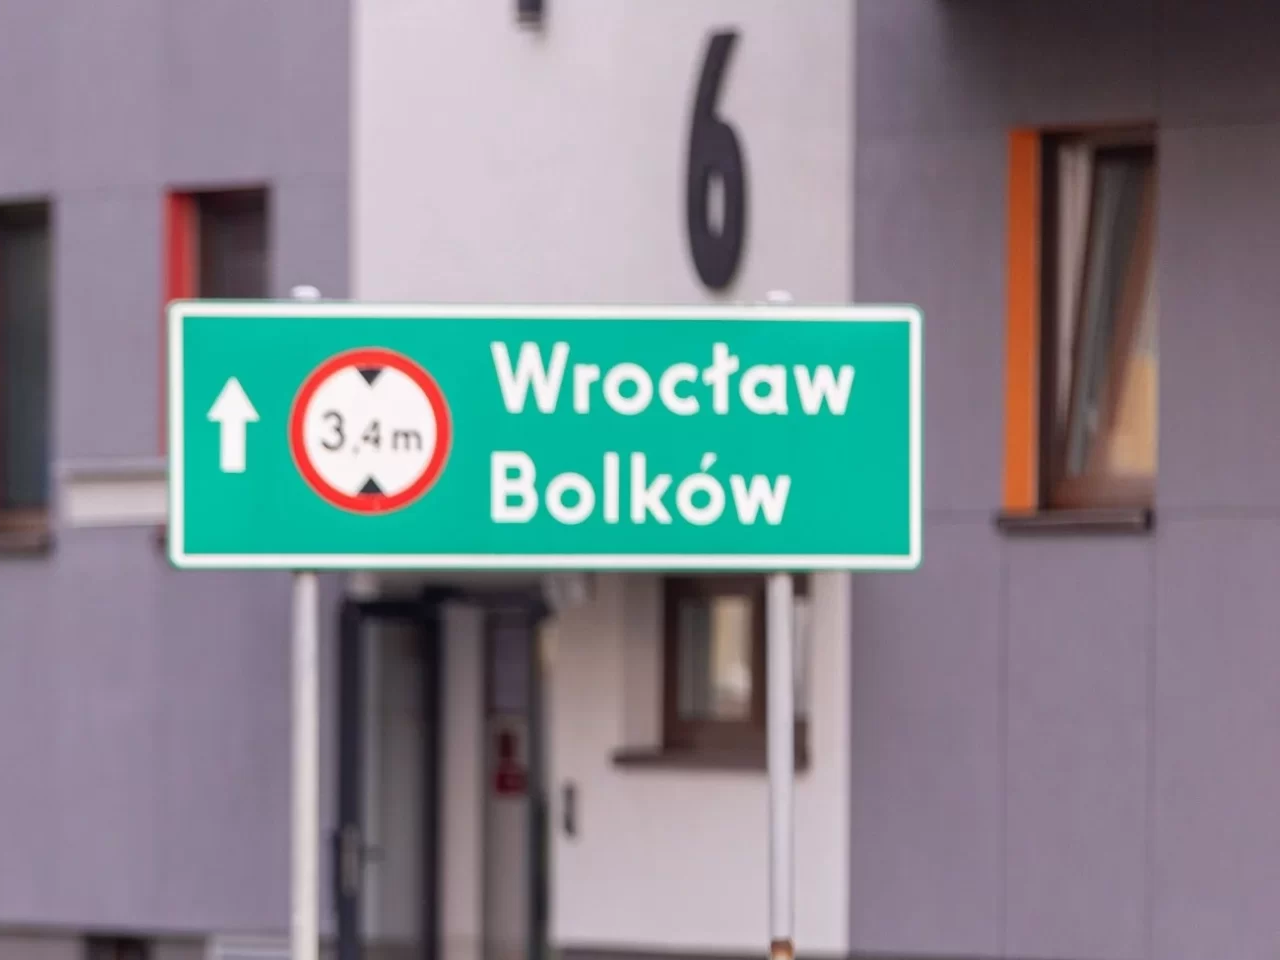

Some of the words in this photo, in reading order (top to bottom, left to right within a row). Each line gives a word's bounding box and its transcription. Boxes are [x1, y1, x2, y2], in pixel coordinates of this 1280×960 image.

[684, 28, 750, 295] 6
[490, 341, 855, 416] Wrocław
[490, 450, 791, 526] Bolków
